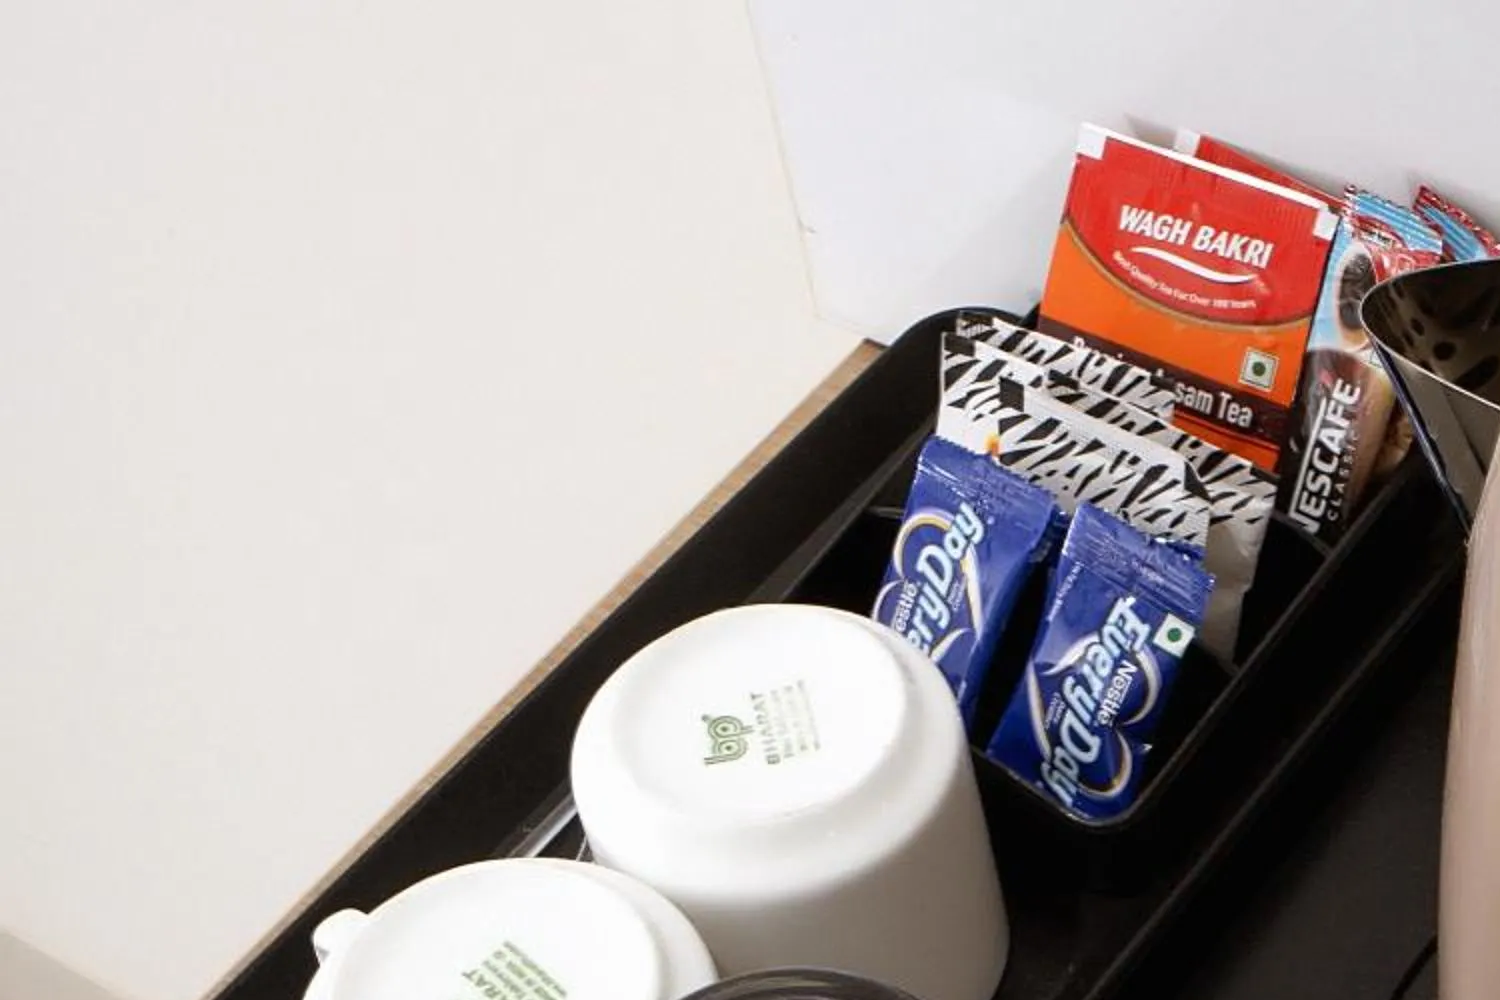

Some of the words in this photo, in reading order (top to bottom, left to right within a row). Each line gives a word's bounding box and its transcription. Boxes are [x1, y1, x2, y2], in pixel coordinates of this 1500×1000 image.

[1118, 205, 1193, 245] WAGH
[1192, 225, 1274, 269] BAKRI
[1216, 391, 1254, 429] Tea
[893, 577, 920, 635] estlé
[904, 502, 985, 653] eryDay
[1039, 595, 1151, 806] EveryDay
